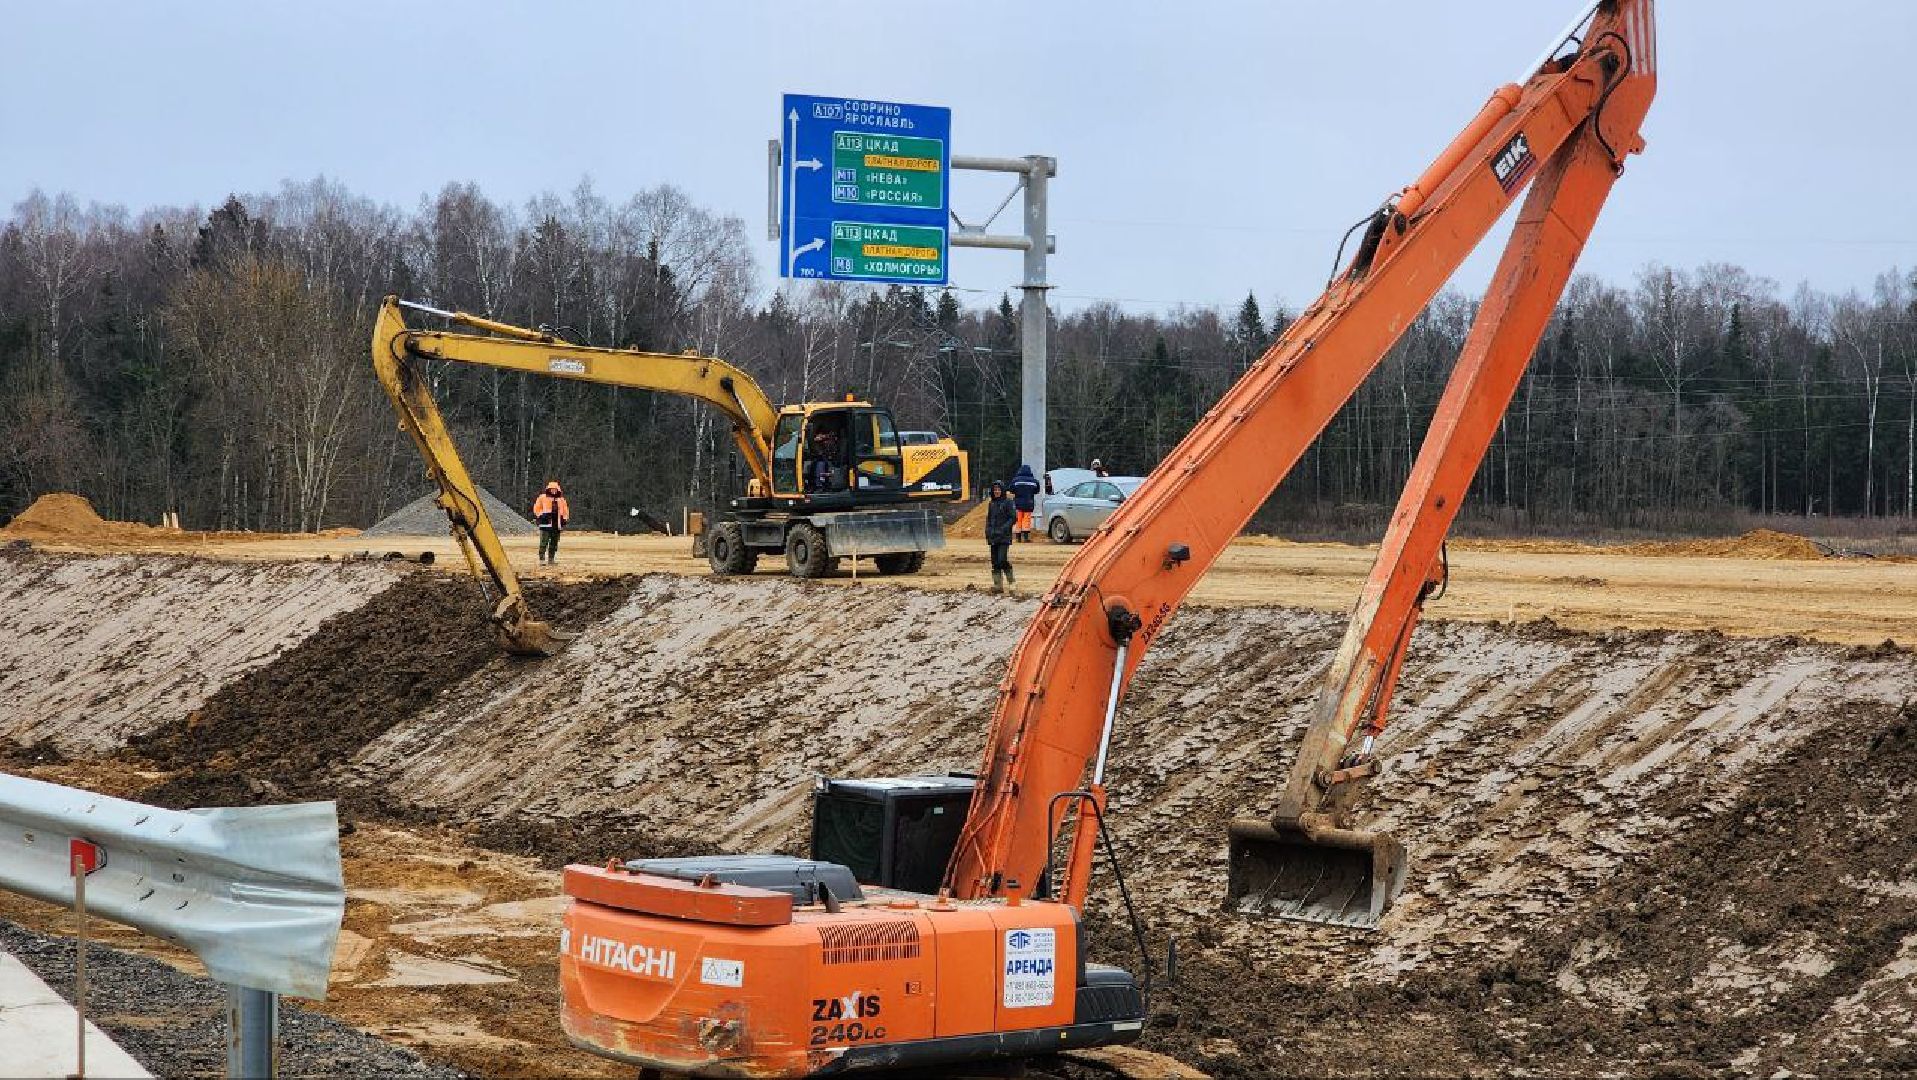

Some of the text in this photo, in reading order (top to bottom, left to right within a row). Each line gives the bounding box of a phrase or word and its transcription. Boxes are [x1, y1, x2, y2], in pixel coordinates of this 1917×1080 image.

[815, 105, 841, 118] А107
[844, 101, 901, 116] СОФРИНО
[845, 113, 914, 129] ЯРОСЛАВЛЬ
[838, 136, 860, 150] А113
[866, 139, 899, 153] ЦКАД
[866, 156, 938, 170] ПЛАТНАЯ ДОРОГА
[1495, 138, 1528, 180] EIK
[866, 173, 908, 185] «НЕВА»
[866, 190, 923, 203] «РОССИЯ»
[836, 226, 859, 239] А113
[864, 229, 898, 242] ЦКАД
[864, 245, 937, 258] ПЛАТНАЯ ДОРОГА
[864, 261, 941, 275] «ХОЛМОГОРЫ»
[581, 934, 676, 979] HITACHI
[1006, 958, 1053, 976] АРЕНДА
[813, 991, 880, 1021] ZAXIS
